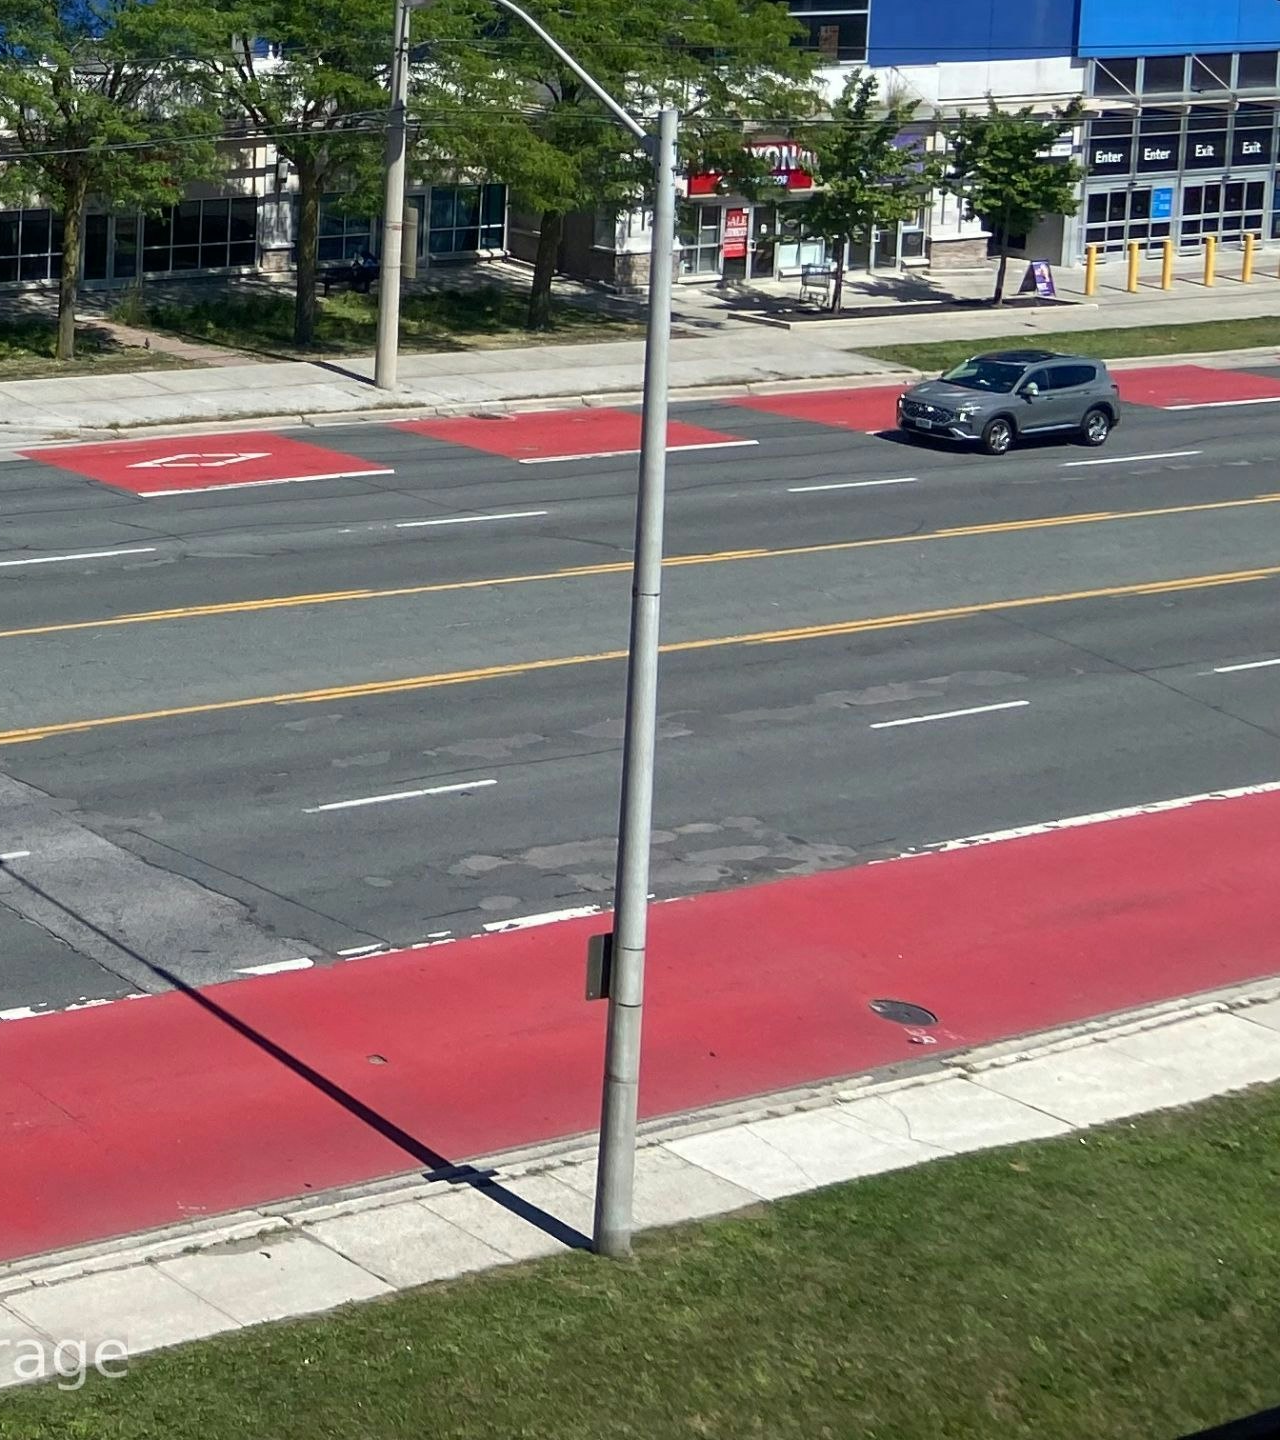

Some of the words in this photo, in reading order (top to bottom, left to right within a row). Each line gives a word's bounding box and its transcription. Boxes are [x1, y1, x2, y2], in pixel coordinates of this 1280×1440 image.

[1144, 147, 1171, 161] Enter
[1195, 144, 1215, 157] Exit
[1242, 141, 1262, 154] Exit
[1095, 150, 1124, 164] Enter
